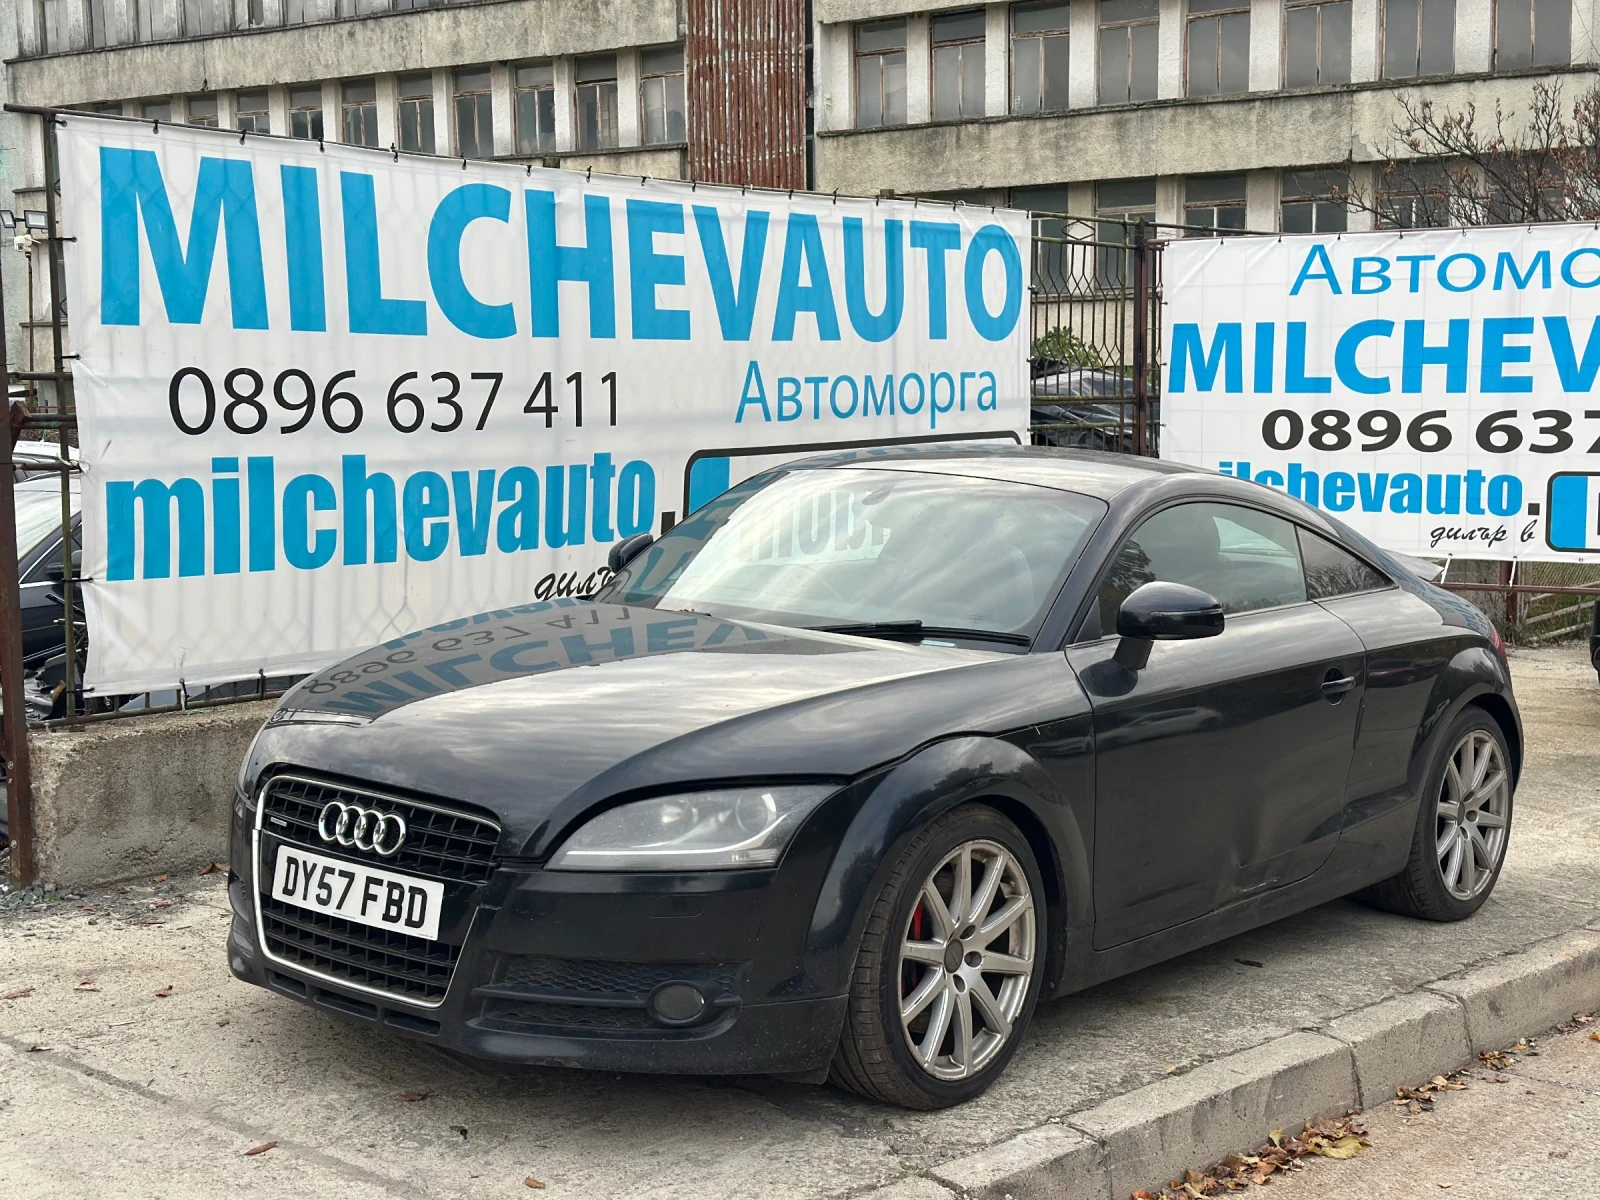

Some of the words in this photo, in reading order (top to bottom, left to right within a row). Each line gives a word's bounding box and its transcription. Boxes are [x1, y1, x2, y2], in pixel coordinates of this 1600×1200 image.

[100, 147, 1022, 342] MILCHEVAUTO
[169, 367, 364, 435] 0896
[386, 372, 504, 433] 637
[523, 372, 617, 428] 411
[735, 360, 997, 429] Автоморга
[1262, 409, 1453, 453] 0896
[1430, 525, 1507, 549] дилър
[281, 856, 356, 910] DY57
[360, 875, 428, 929] FBD
